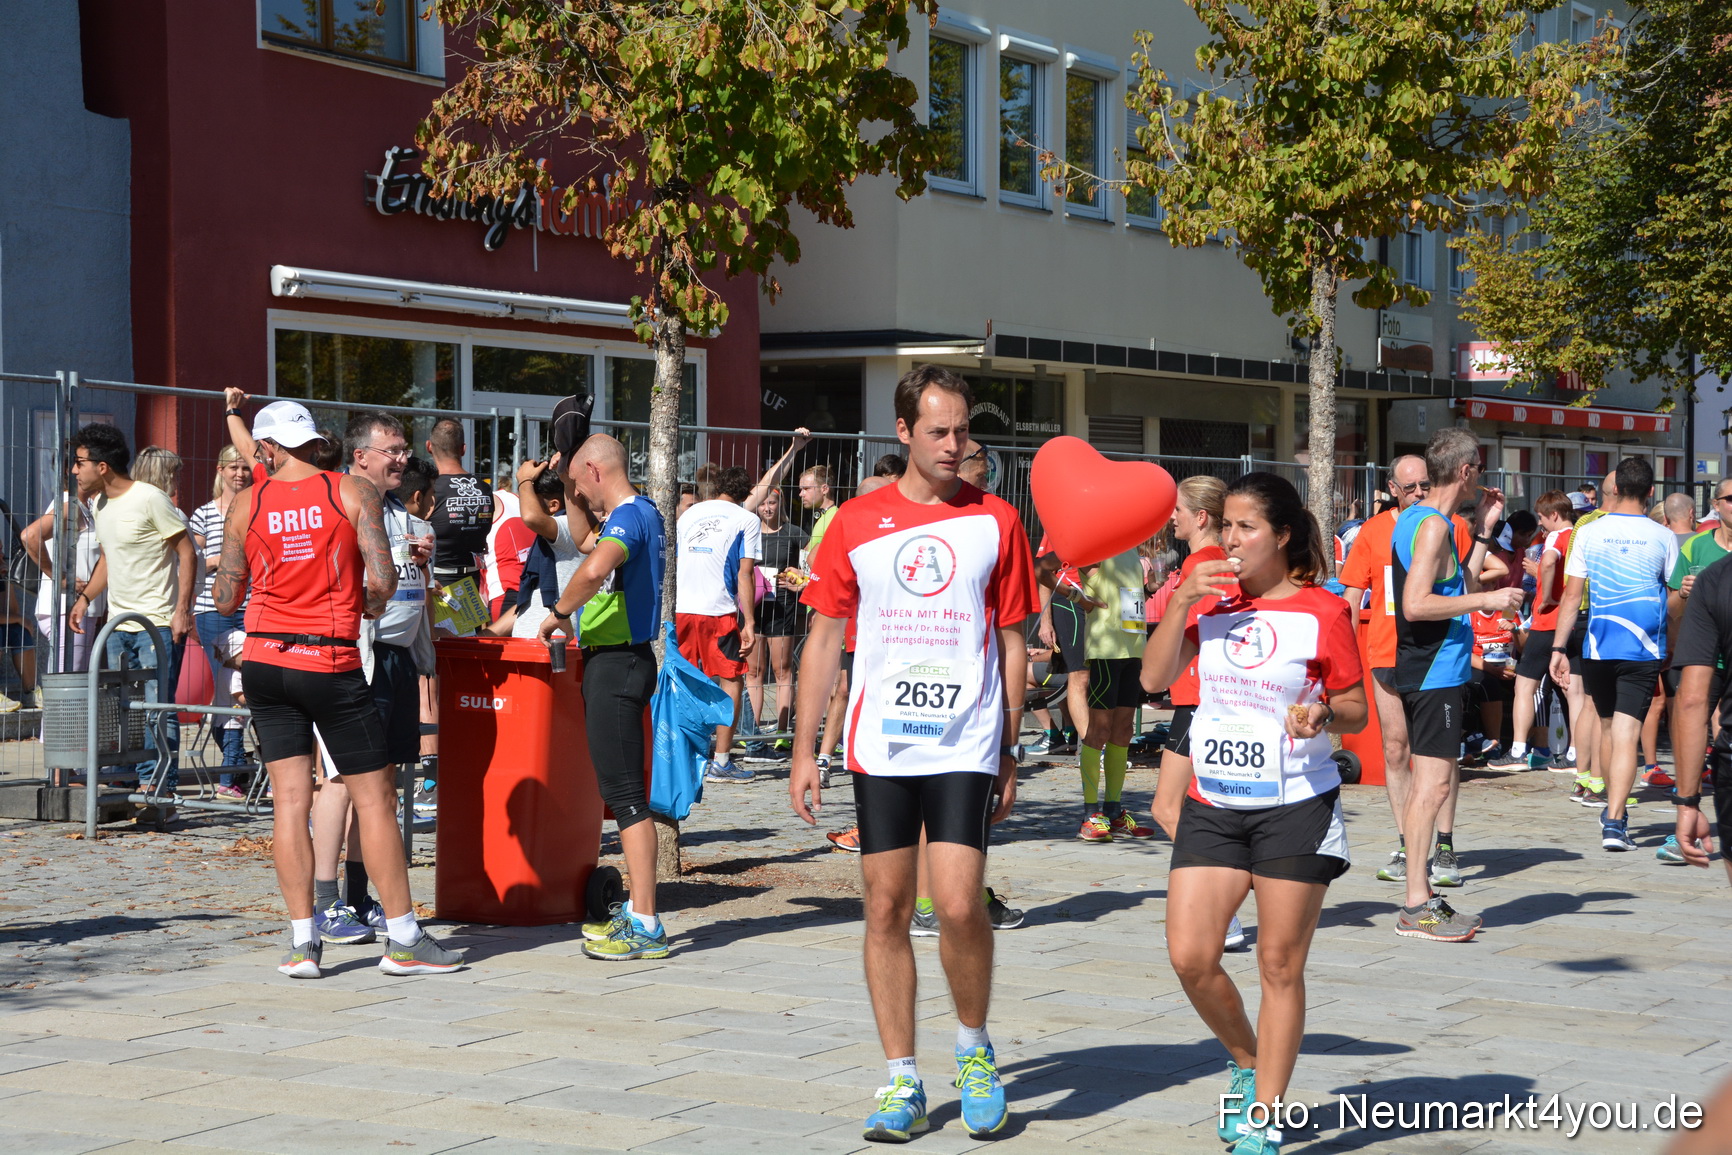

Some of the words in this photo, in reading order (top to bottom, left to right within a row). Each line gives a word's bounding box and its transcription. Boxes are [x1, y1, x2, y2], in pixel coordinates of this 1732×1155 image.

[1382, 313, 1401, 336] Foto
[1471, 401, 1487, 418] NKD
[1513, 406, 1527, 422] NKD
[1551, 410, 1565, 425] NKD
[1588, 412, 1600, 428] NKD
[1622, 416, 1634, 430] NKD
[1016, 422, 1039, 432] ELSBETH
[1040, 422, 1061, 432] MÜLLER
[446, 496, 491, 507] PIRATE
[268, 505, 323, 534] BRIG
[282, 533, 311, 542] Burgstaller
[283, 540, 313, 549] Ramazzotti
[283, 547, 313, 556] Interessens
[281, 553, 315, 562] Gemeinschaft
[463, 580, 486, 621] URKUNDE
[918, 609, 938, 618] MIT
[881, 623, 893, 631] Dr.
[920, 624, 932, 632] Dr.
[934, 625, 960, 633] Röschl
[882, 635, 959, 646] Leistungsdiagnostik
[286, 645, 321, 656] Mörlach
[909, 664, 950, 676] BOCK
[1241, 678, 1257, 688] MIT
[895, 680, 962, 710] 2637
[1219, 687, 1238, 695] Heck
[1244, 690, 1254, 698] Dr.
[1255, 692, 1277, 703] Röschl
[460, 695, 504, 711] SULO
[902, 722, 944, 736] Matthia
[1219, 723, 1253, 734] BOCK
[1204, 738, 1265, 768] 2638
[1227, 770, 1253, 778] Neumarkt
[1218, 781, 1252, 795] Sevinc
